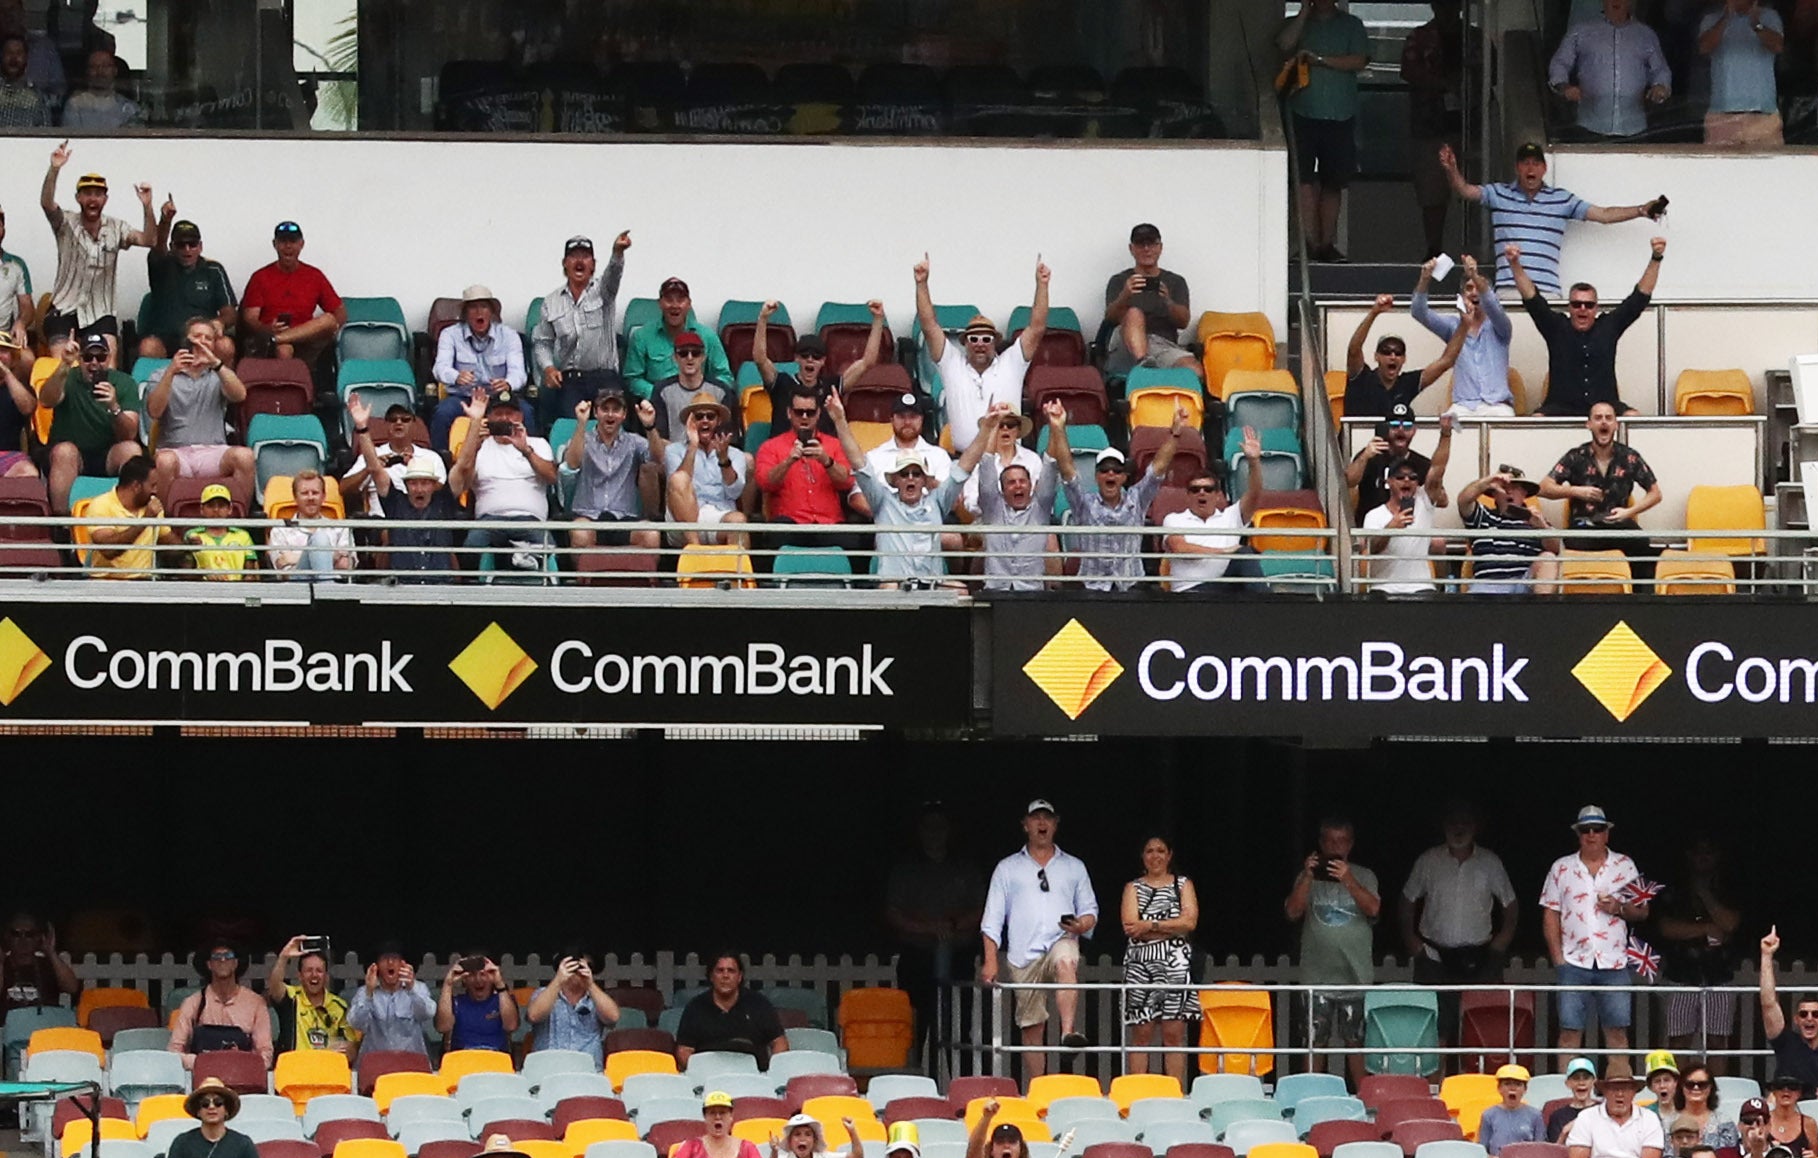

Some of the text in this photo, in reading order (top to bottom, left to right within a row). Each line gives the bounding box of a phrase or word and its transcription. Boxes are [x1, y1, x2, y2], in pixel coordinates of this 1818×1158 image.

[65, 635, 413, 692] CommBank
[550, 641, 894, 695] CommBank
[1138, 641, 1529, 702] CommBank
